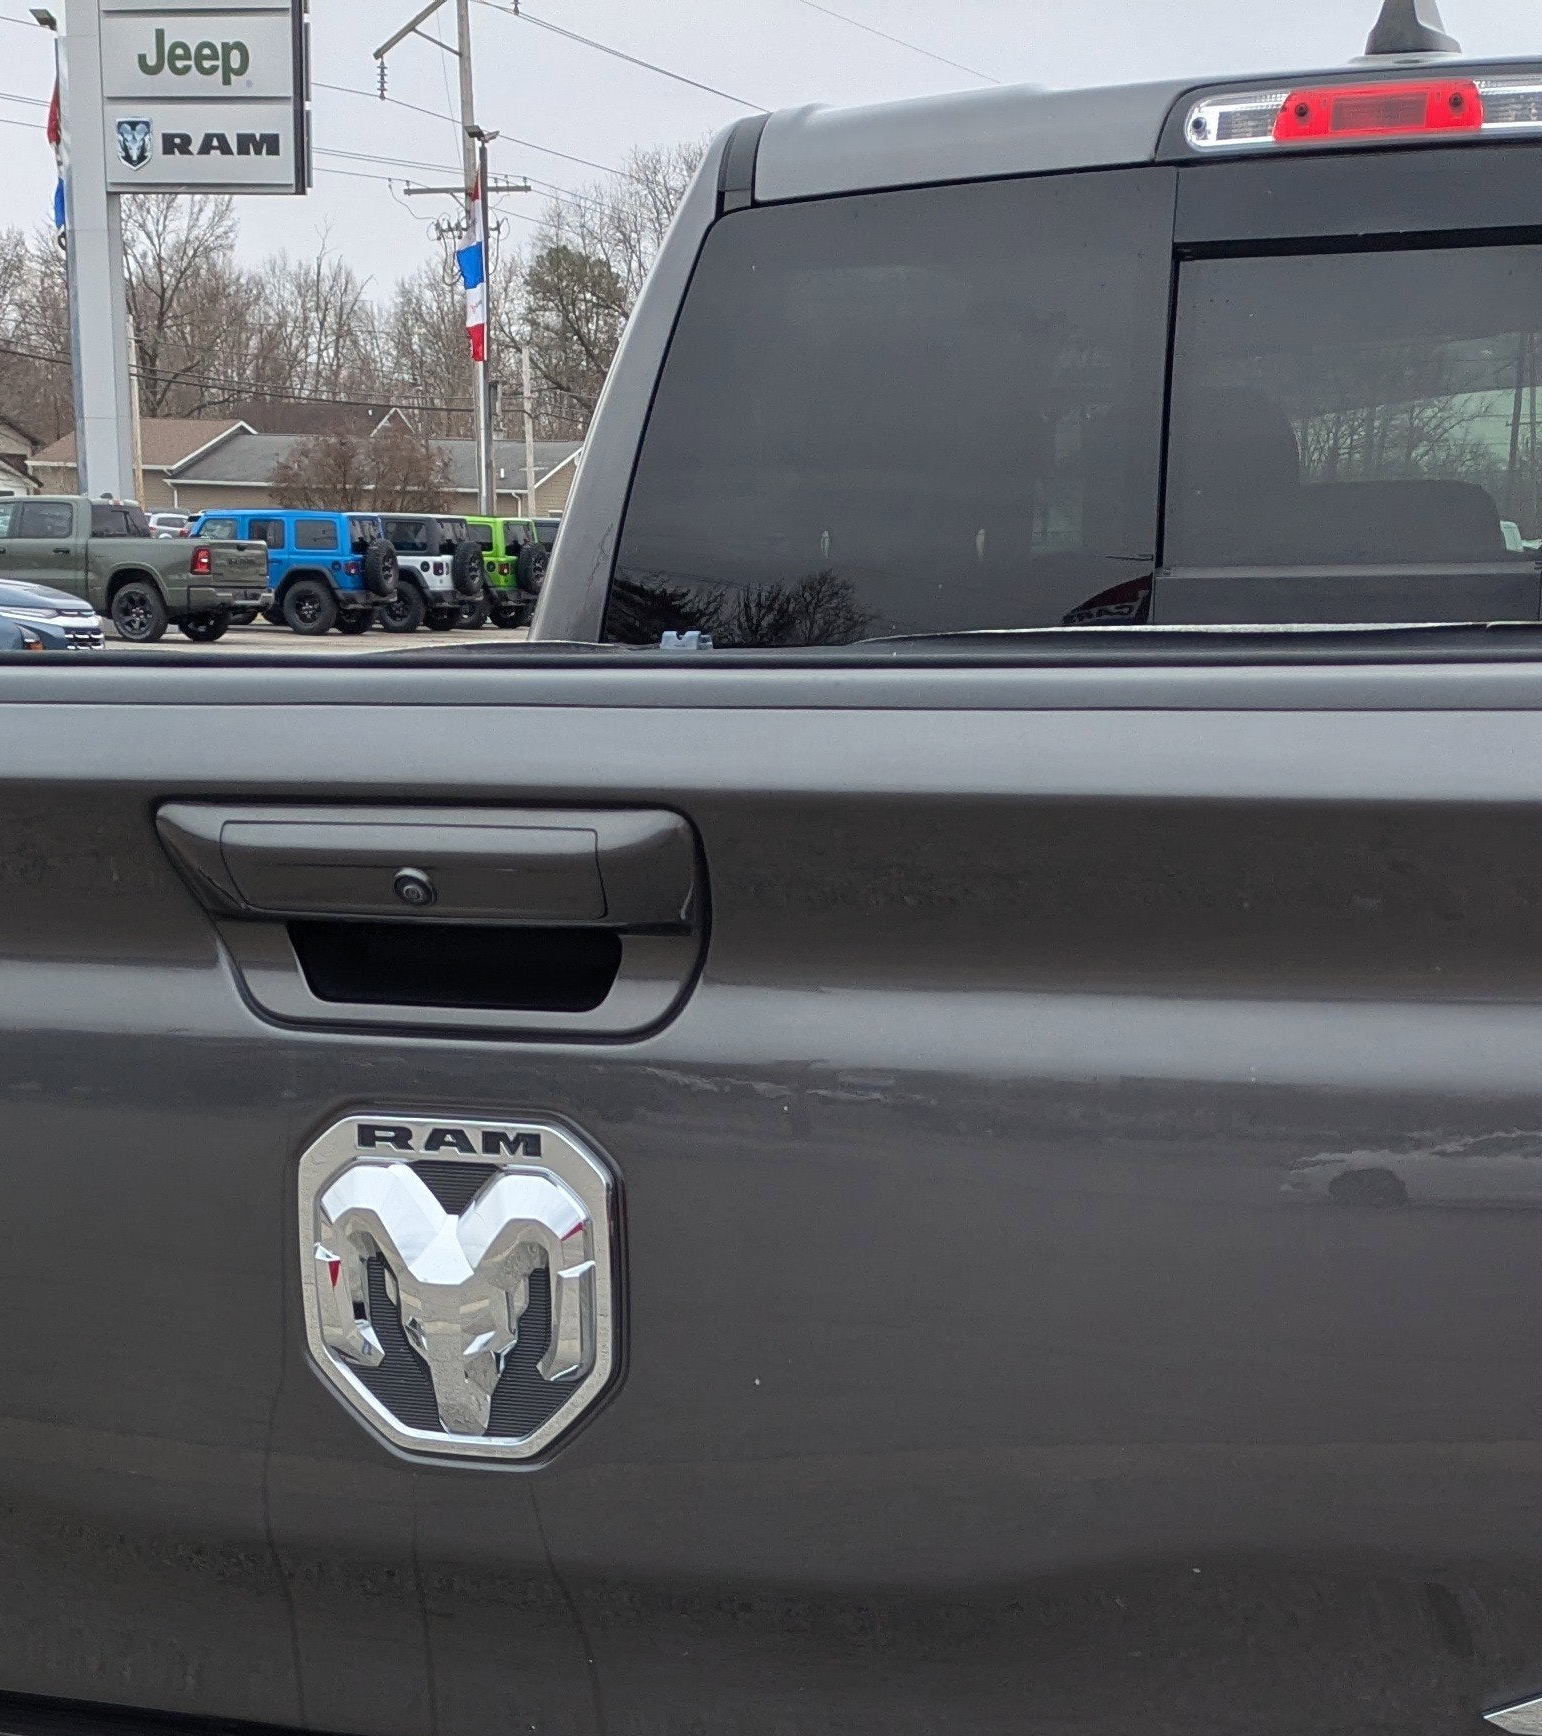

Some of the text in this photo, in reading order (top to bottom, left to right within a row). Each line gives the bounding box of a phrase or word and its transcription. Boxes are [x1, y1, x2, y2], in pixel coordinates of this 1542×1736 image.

[138, 28, 249, 85] Jeep
[161, 133, 280, 156] RAM
[358, 1123, 542, 1157] RAM
